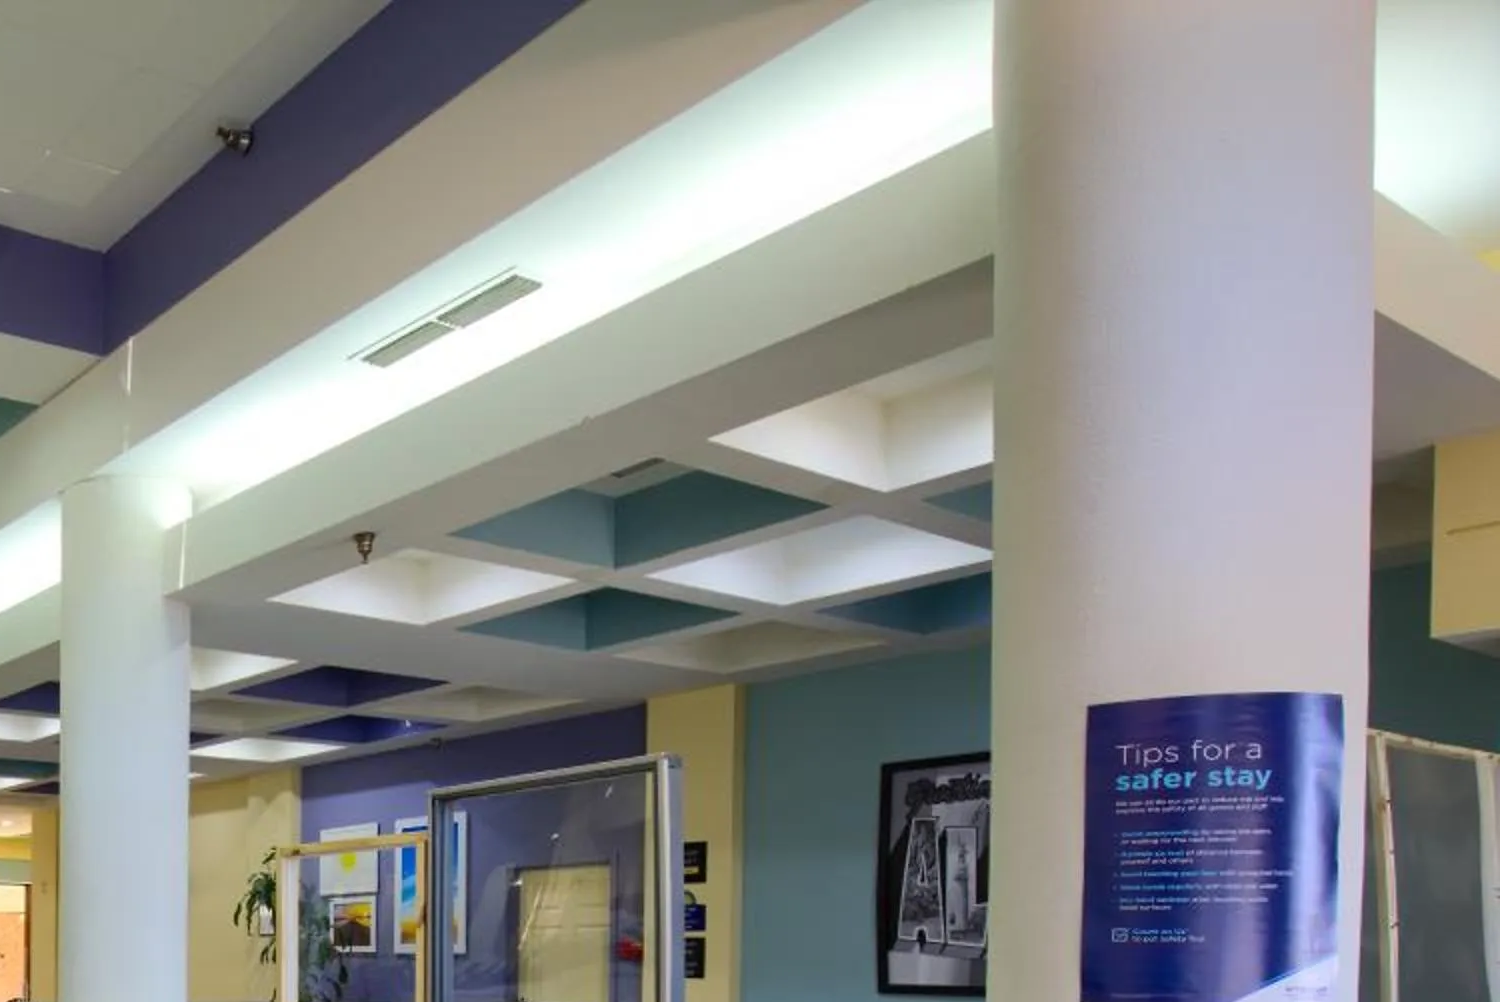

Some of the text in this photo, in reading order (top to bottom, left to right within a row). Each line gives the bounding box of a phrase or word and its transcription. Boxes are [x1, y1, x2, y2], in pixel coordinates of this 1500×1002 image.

[1115, 739, 1263, 768] Tips for a
[1115, 766, 1273, 791] safer stay
